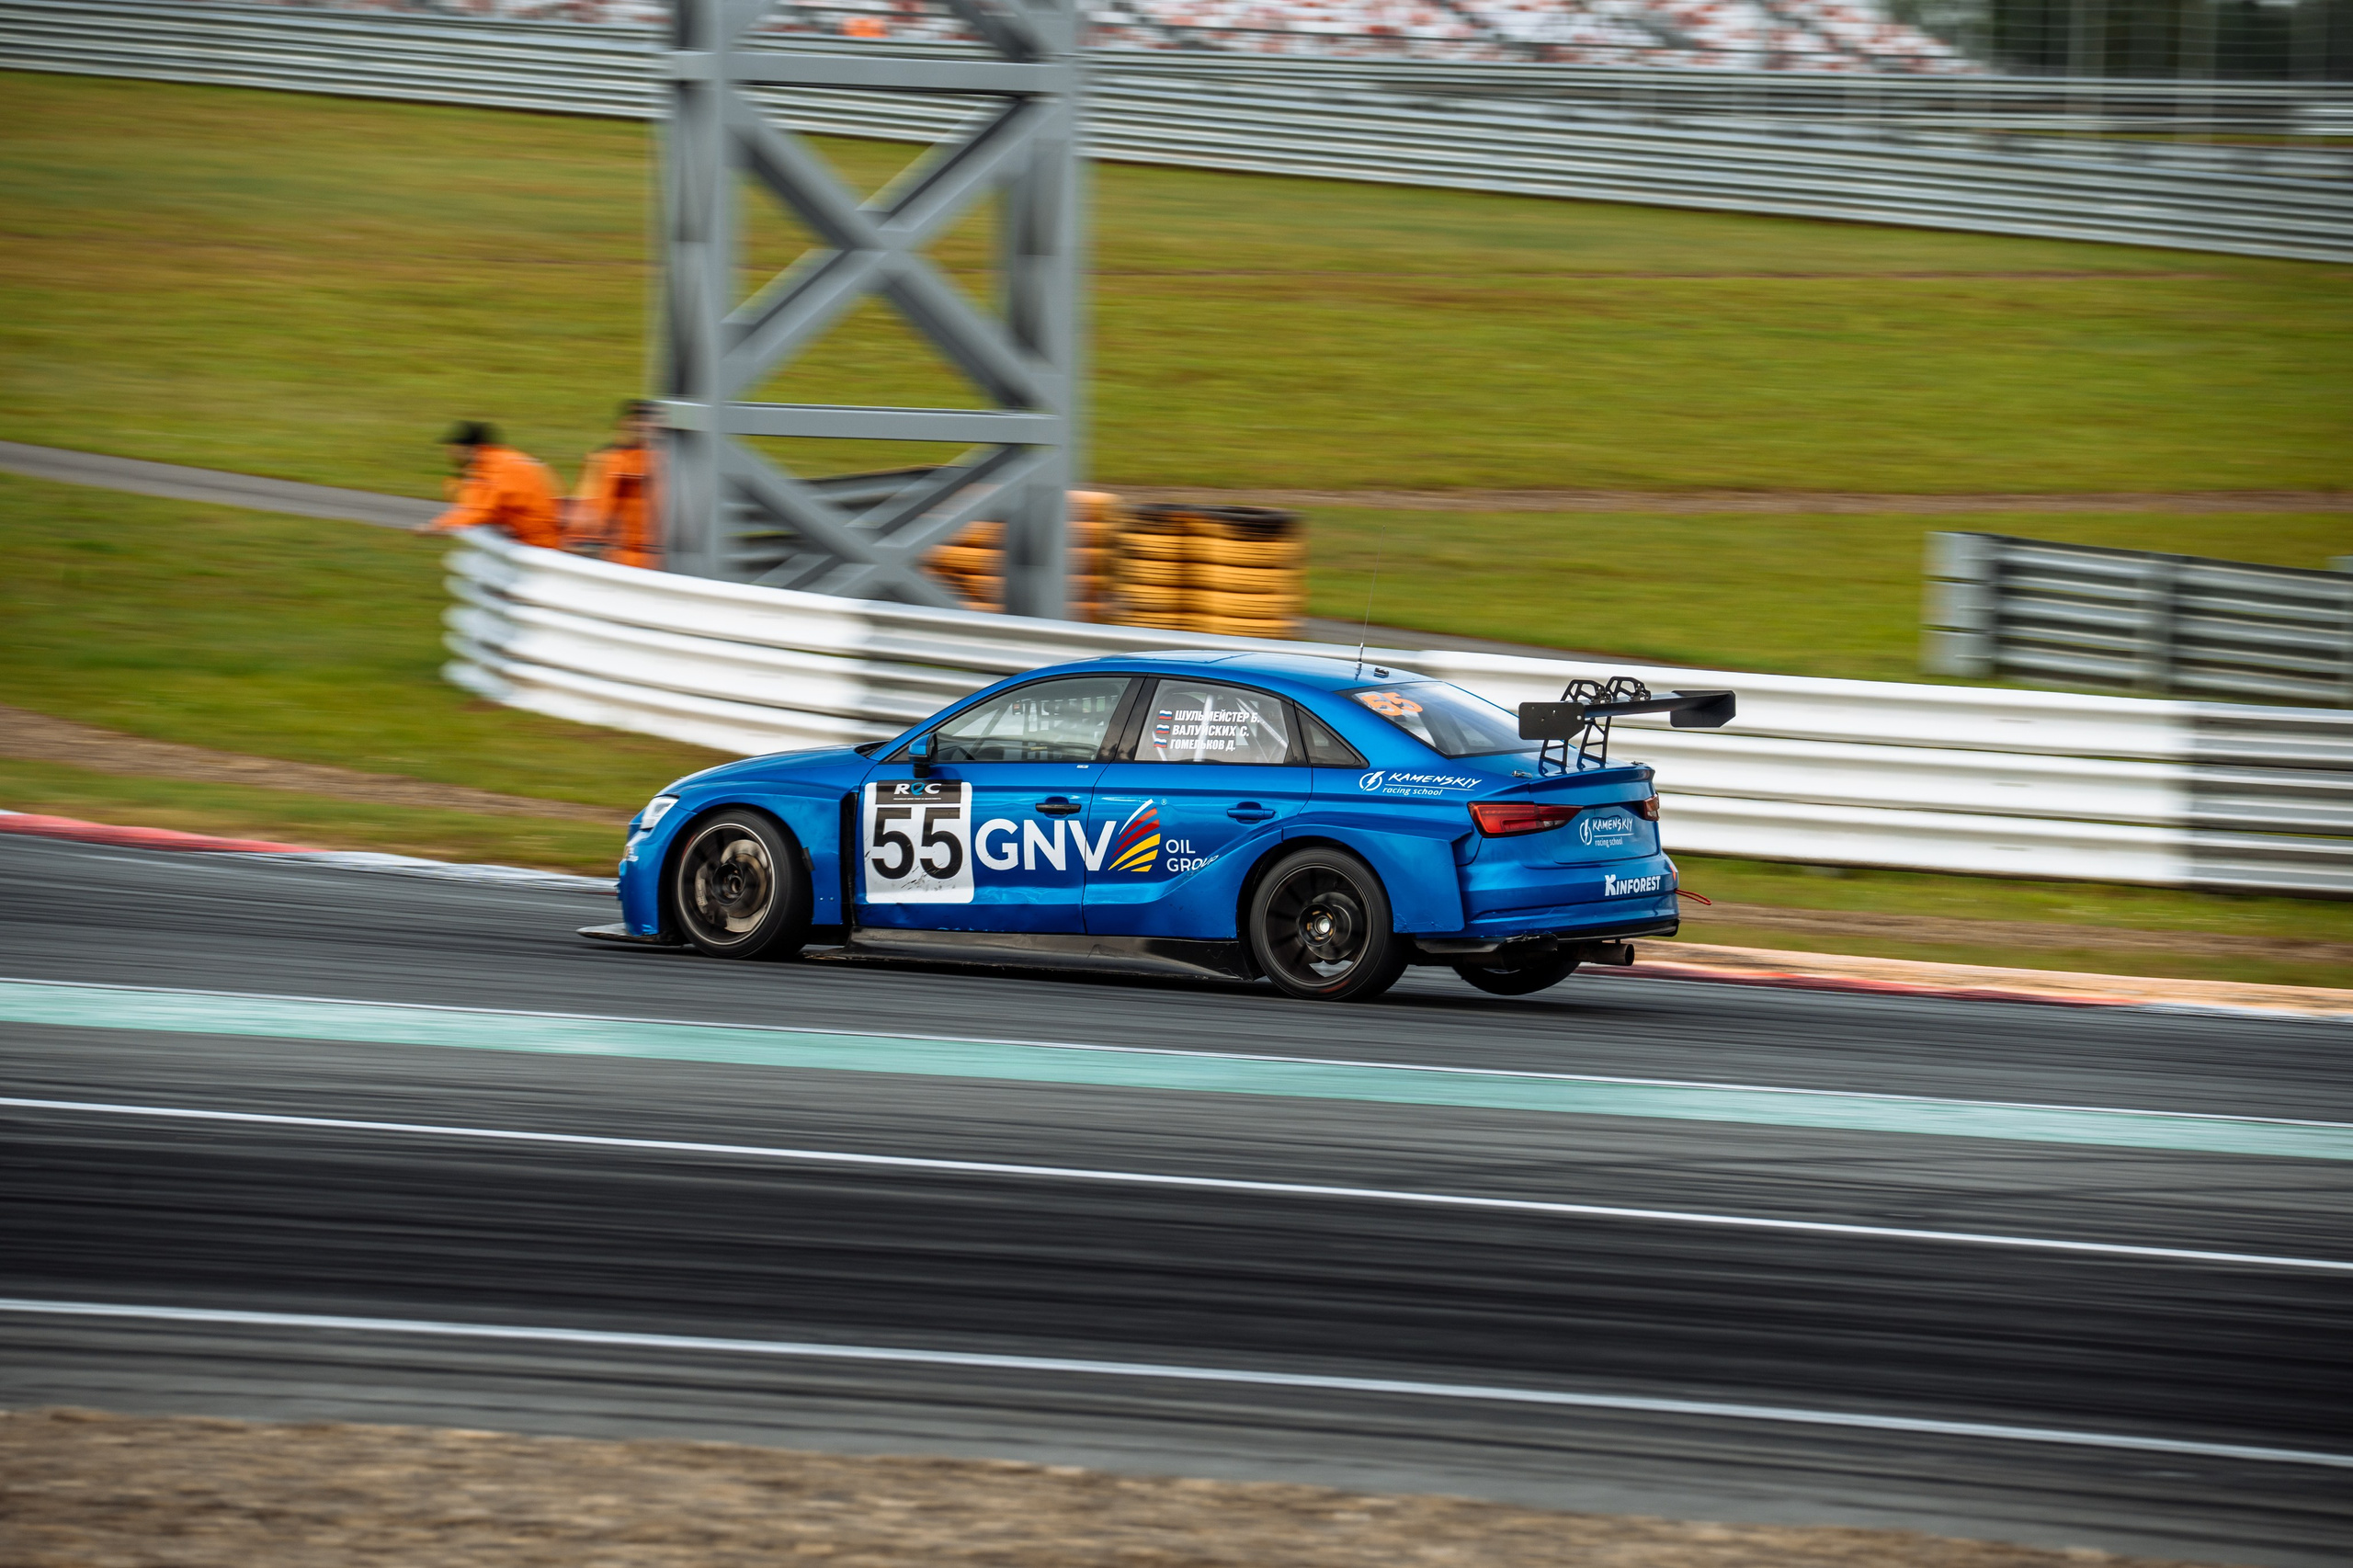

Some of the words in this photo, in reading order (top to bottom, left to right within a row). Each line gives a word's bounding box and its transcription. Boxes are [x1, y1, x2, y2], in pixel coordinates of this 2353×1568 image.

[1388, 772, 1483, 790] KAMENSKIY
[1382, 787, 1411, 796] racing
[1413, 788, 1443, 797] school
[1592, 817, 1633, 833] KAMENSKIY
[871, 807, 963, 880] 55
[975, 819, 1117, 871] GNV
[1165, 839, 1196, 854] OIL
[1595, 839, 1609, 847] racing
[1608, 837, 1623, 846] school
[1605, 874, 1661, 896] KINFOREST
